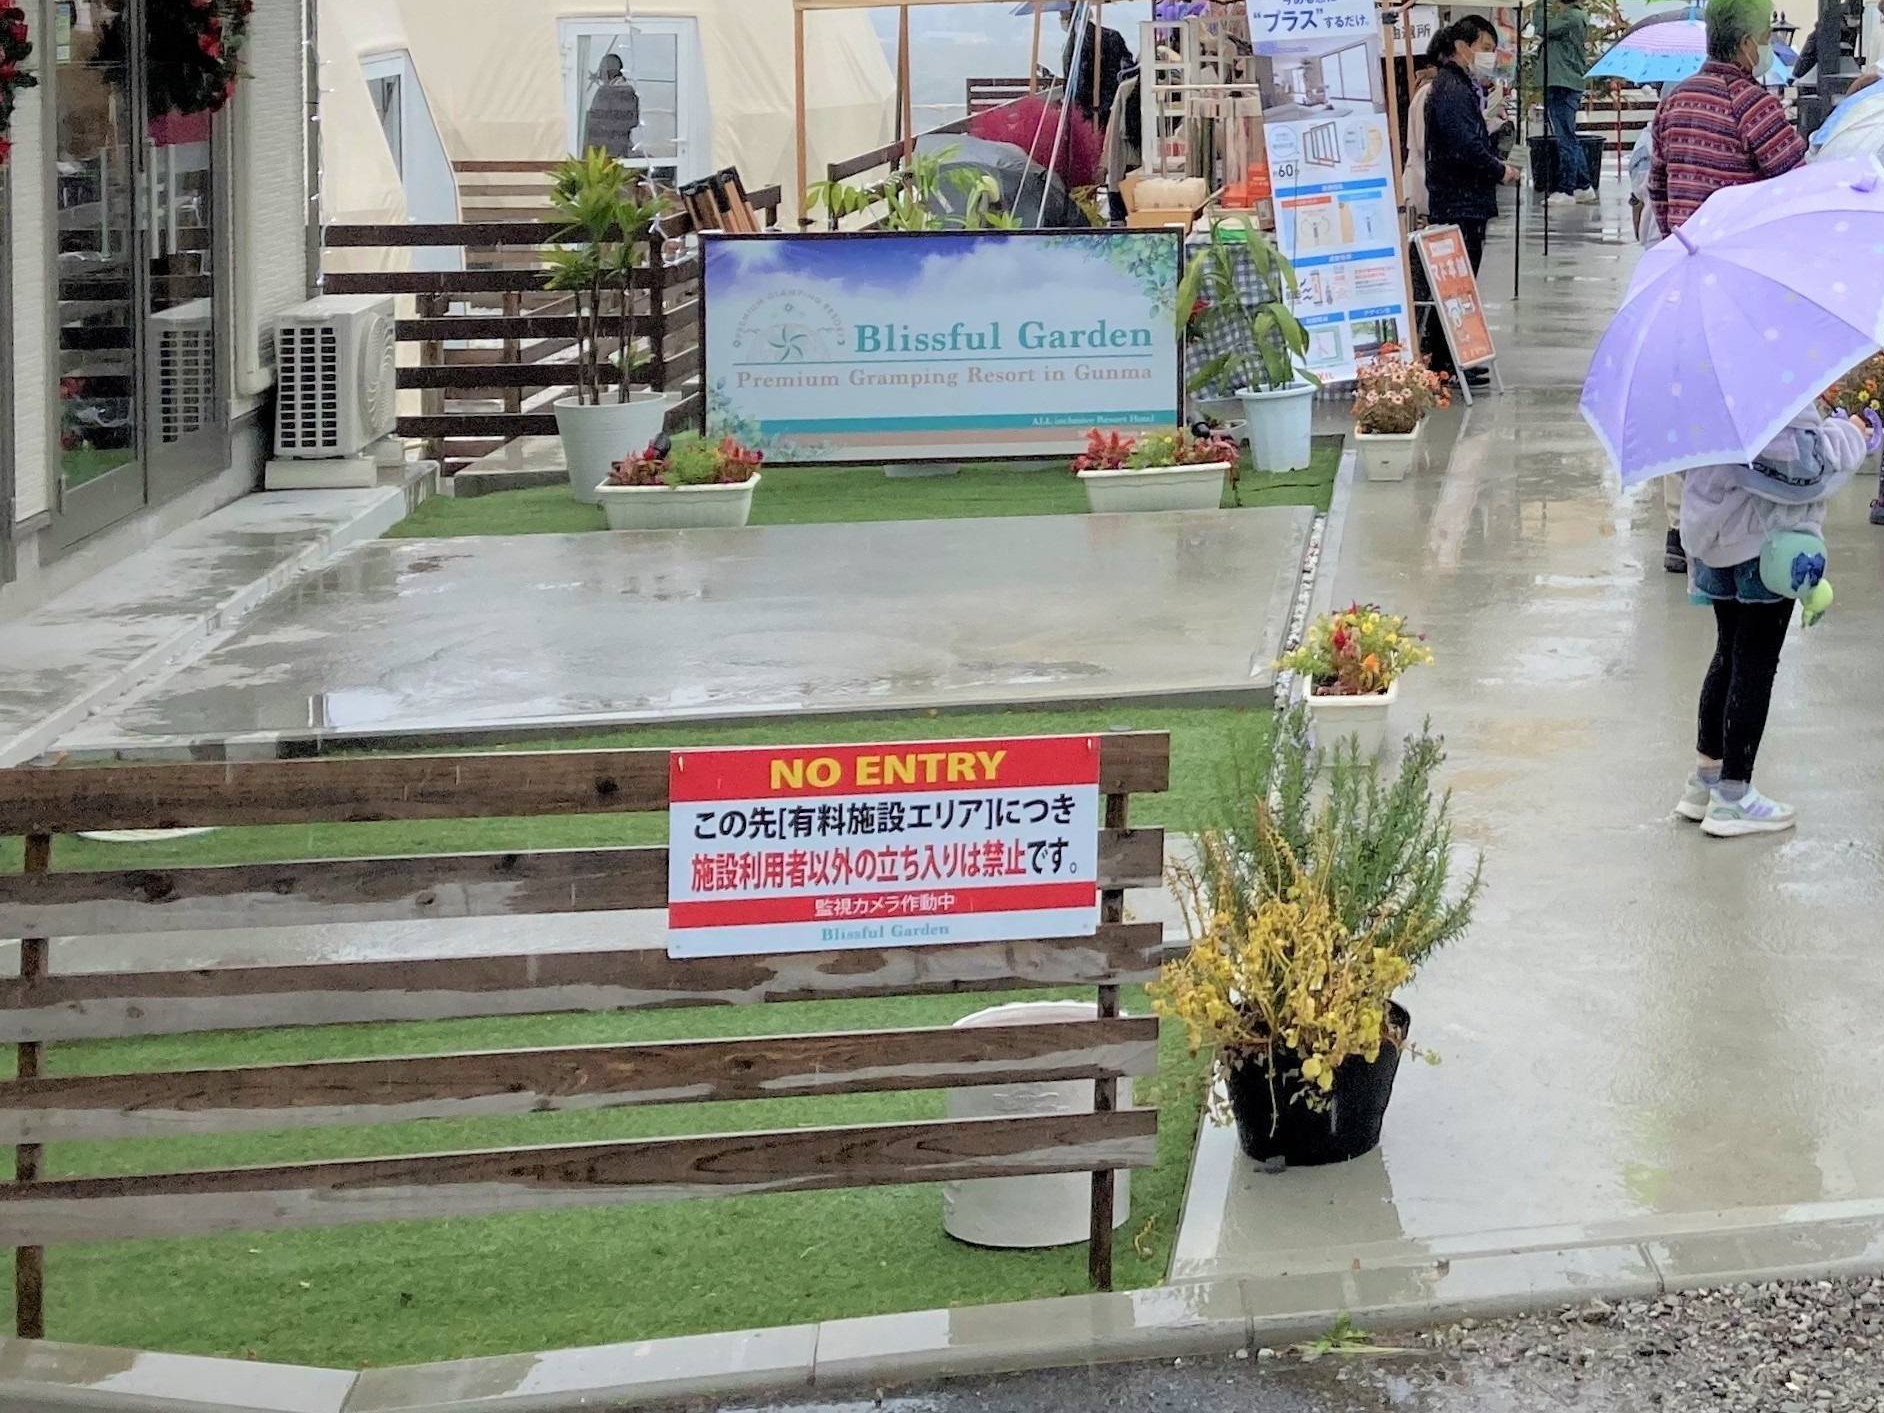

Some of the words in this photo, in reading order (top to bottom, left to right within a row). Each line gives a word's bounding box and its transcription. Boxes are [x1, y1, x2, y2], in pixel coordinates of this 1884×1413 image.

[854, 321, 1002, 353] Blissful
[1018, 320, 1153, 349] Garden
[736, 371, 840, 389] Premium
[849, 368, 959, 388] Gramping
[967, 366, 1034, 384] Resort
[1044, 365, 1064, 382] in
[1074, 363, 1152, 381] Gunma
[769, 756, 842, 790] NO
[855, 749, 1008, 786] ENTRY
[692, 792, 1077, 840] この先[有料施設エリア]につき
[690, 835, 1078, 893] 施設利用者以外の立ち入りは禁止です。
[814, 892, 956, 917] 監視カメラ作動中
[821, 924, 884, 941] Blissful
[890, 922, 950, 938] Garden
